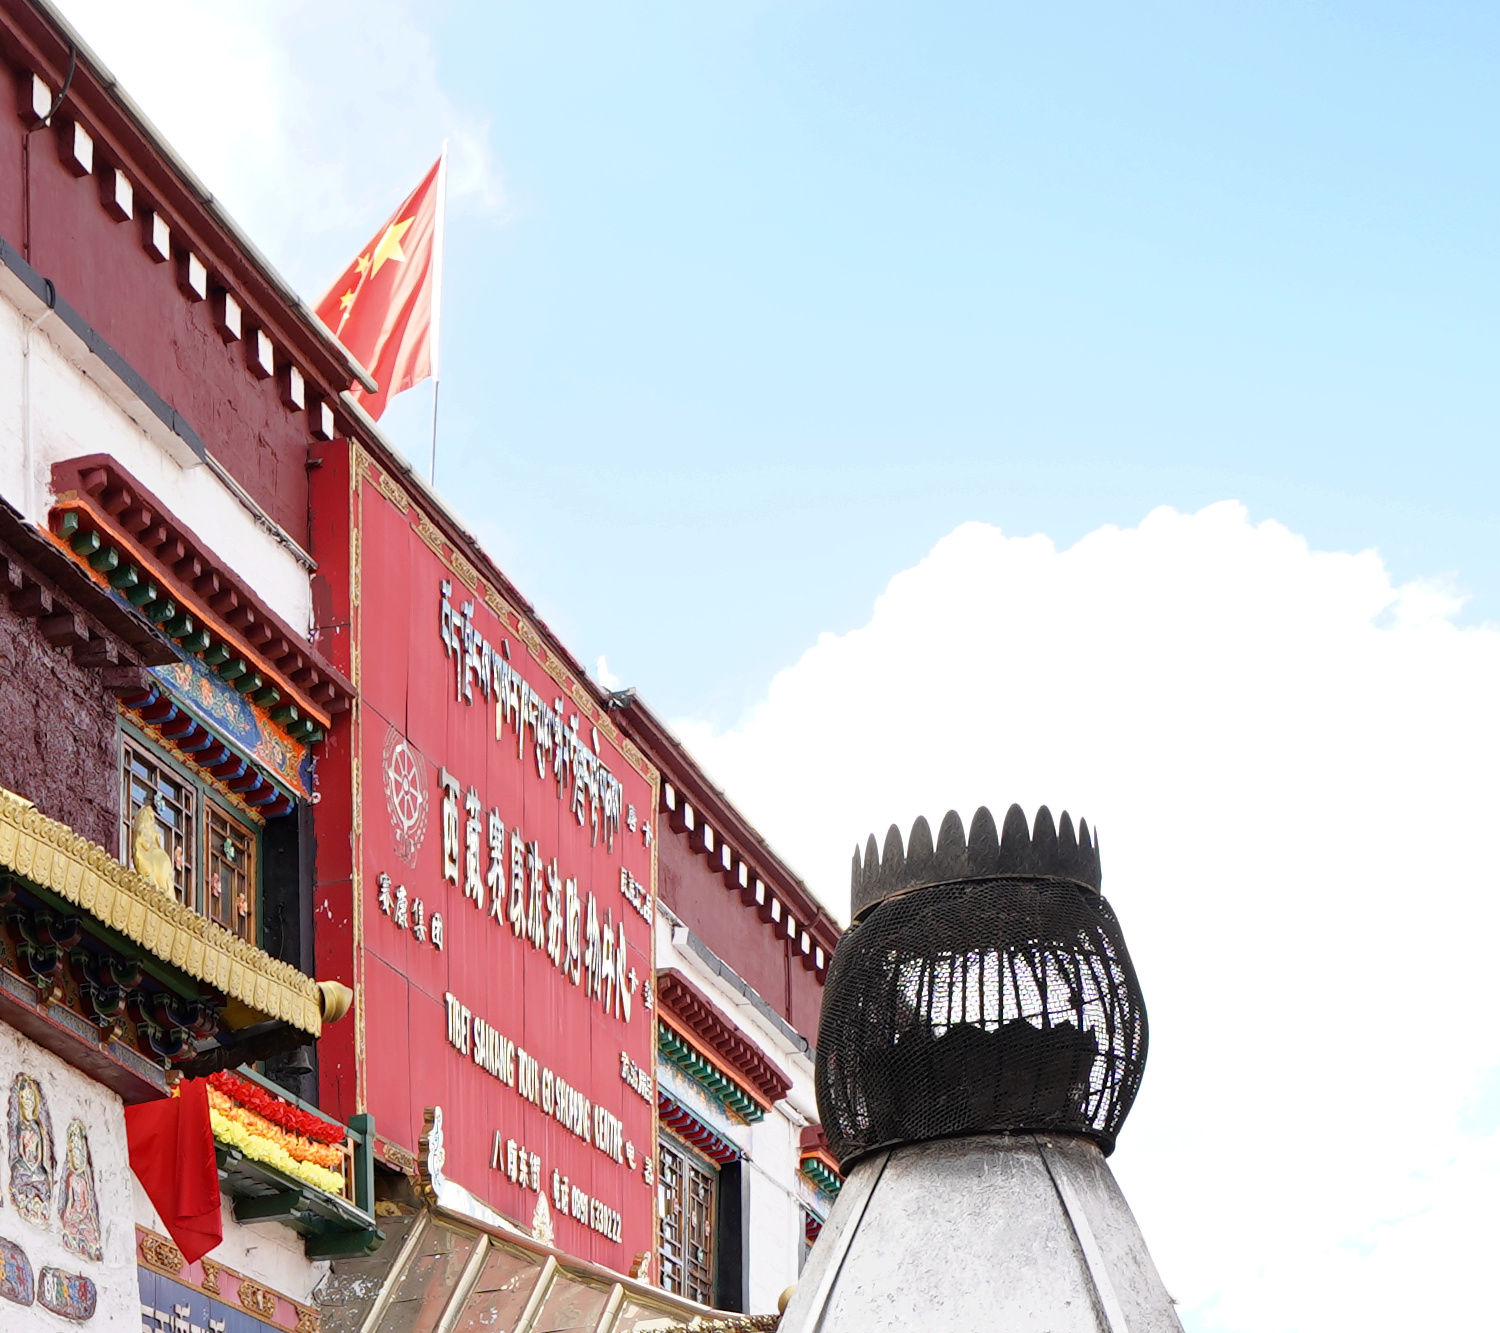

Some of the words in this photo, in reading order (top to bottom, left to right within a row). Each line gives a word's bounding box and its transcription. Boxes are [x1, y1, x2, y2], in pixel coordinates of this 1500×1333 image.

[377, 871, 444, 952] 赛康集团
[438, 766, 631, 1023] 西藏赛康旅游购物中心
[445, 991, 471, 1056] TIBET
[472, 1016, 515, 1088] SAIKANG
